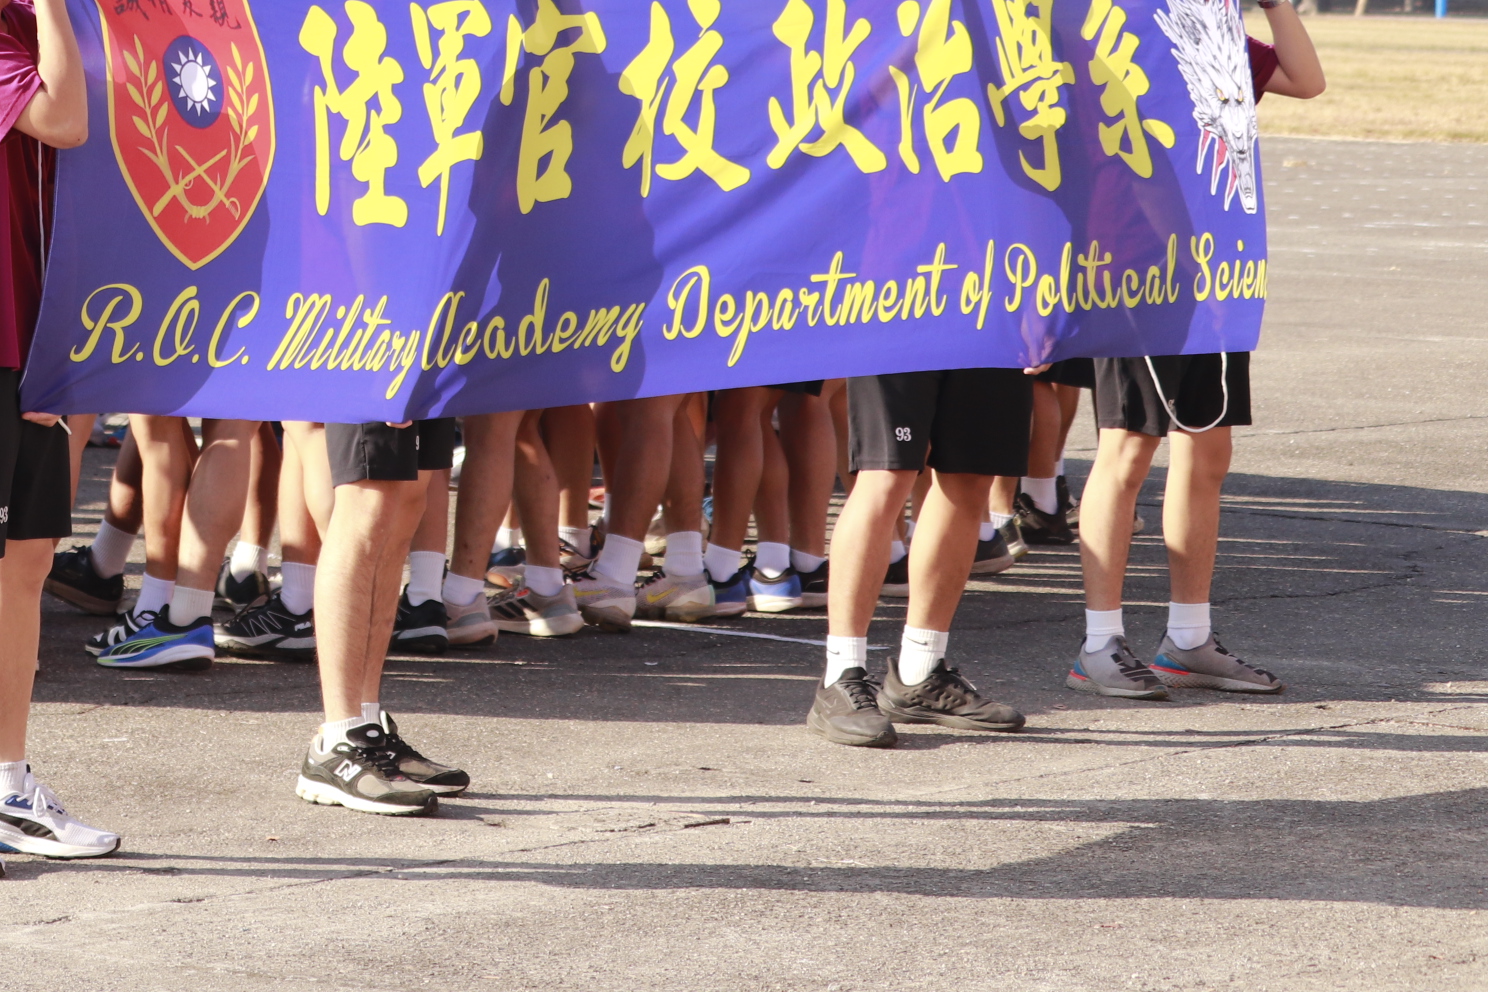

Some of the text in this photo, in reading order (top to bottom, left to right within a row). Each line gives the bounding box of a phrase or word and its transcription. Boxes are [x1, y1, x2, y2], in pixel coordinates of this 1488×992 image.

[70, 283, 260, 368] R.O.C.
[267, 292, 421, 400] Military
[421, 278, 645, 373] Academy
[663, 251, 958, 367] Department
[960, 239, 994, 330] of
[1005, 233, 1179, 318] Political
[895, 427, 912, 442] 93
[0, 506, 9, 524] 93
